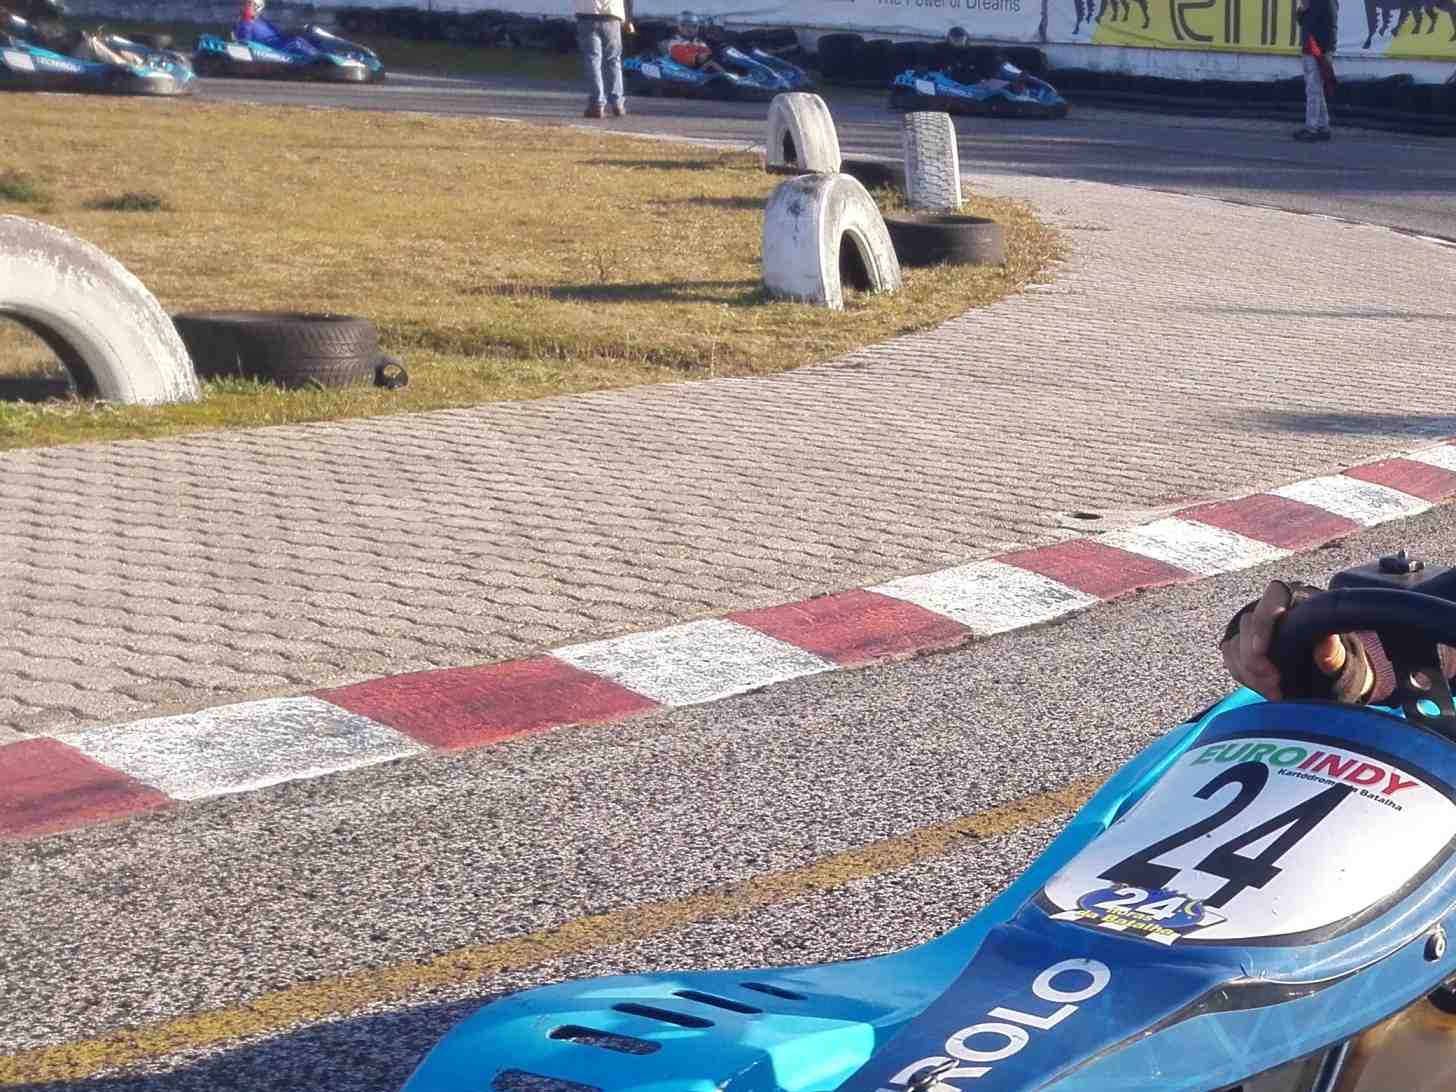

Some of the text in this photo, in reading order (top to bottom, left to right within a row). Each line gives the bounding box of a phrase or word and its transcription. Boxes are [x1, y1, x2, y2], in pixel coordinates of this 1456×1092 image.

[1190, 742, 1418, 796] EUROINDY
[1277, 767, 1339, 787] Kartódrom
[1359, 789, 1402, 812] Batalha
[1097, 761, 1356, 910] 24
[1093, 887, 1188, 921] 24
